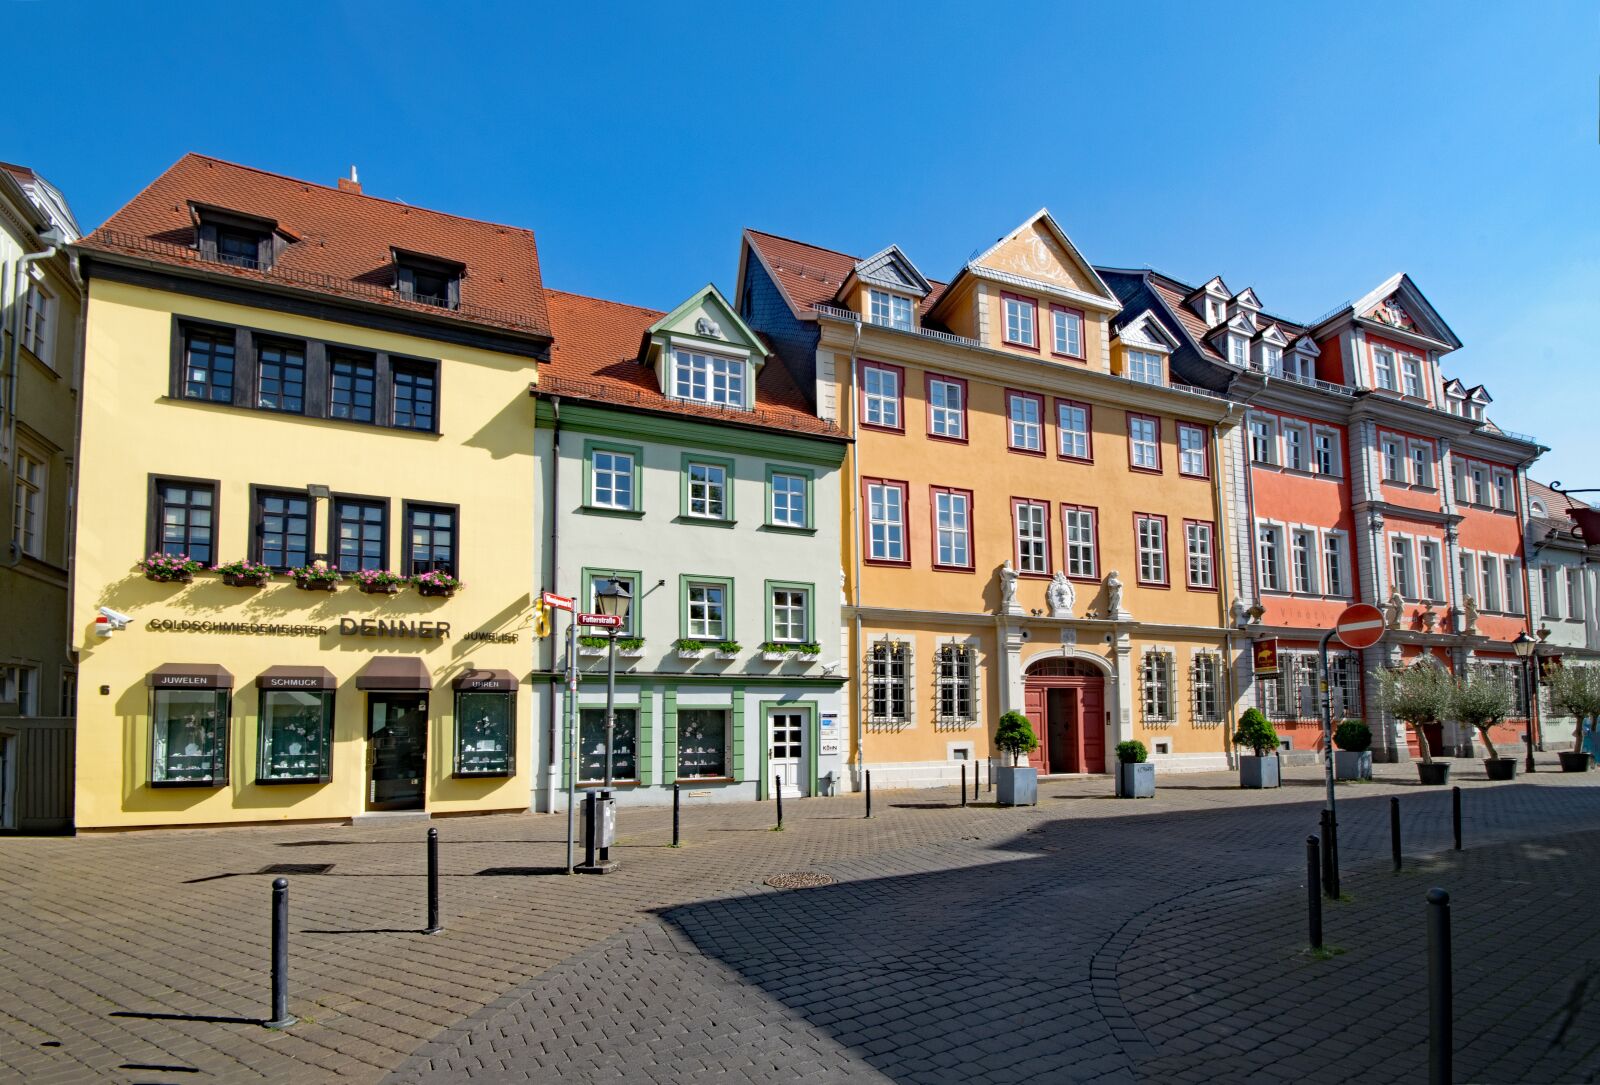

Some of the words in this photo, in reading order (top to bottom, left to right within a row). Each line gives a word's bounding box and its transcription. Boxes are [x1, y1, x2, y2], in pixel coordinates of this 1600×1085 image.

[582, 615, 616, 625] Futterstraße
[149, 618, 328, 636] GOLDSCHMIEDEMEISTER
[339, 617, 451, 639] DENNER
[161, 676, 208, 685] JUWELEN
[271, 678, 318, 687] SCHMUCK
